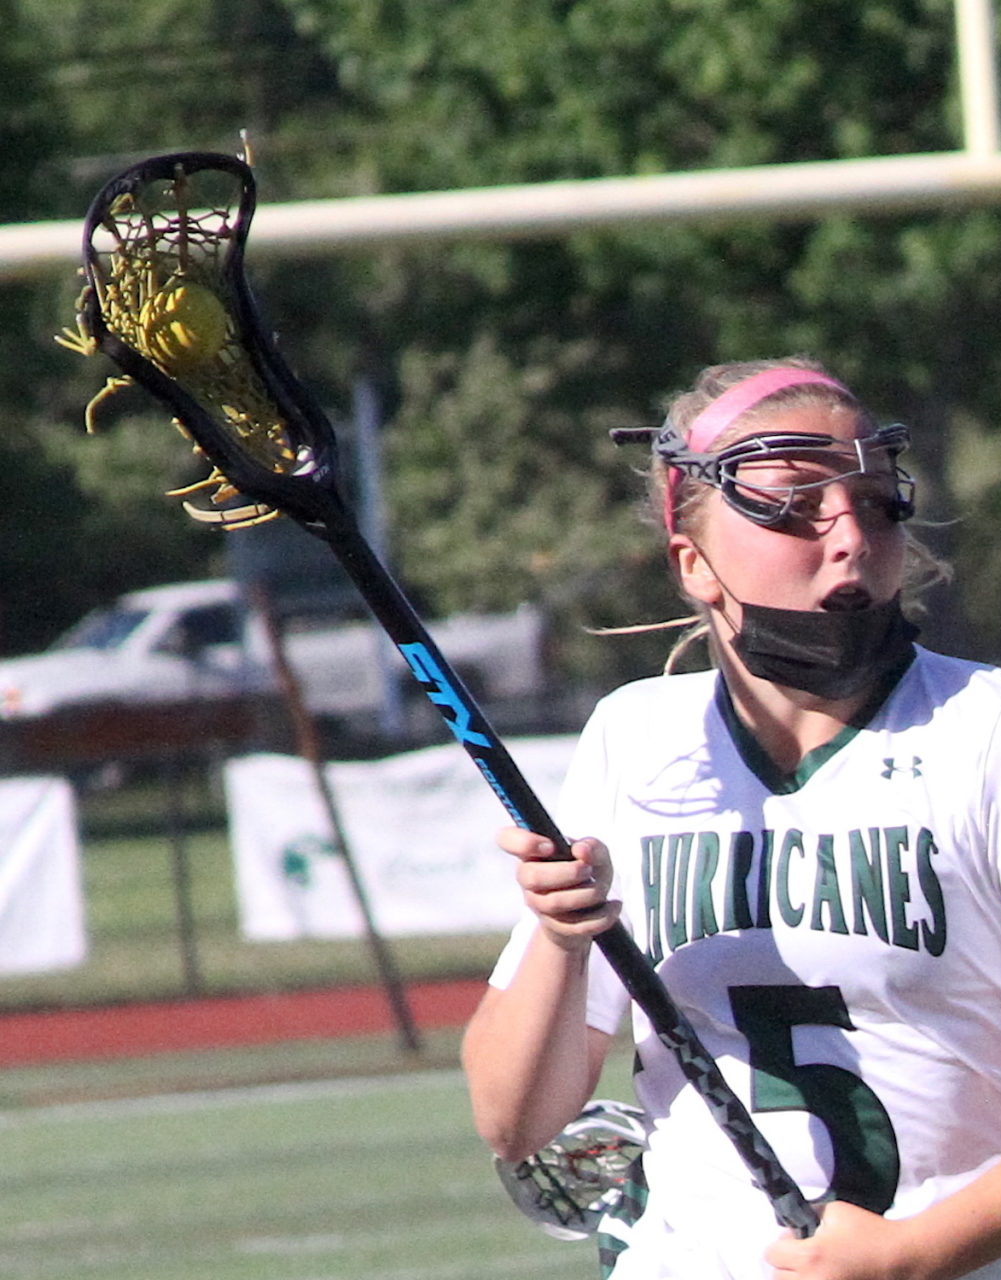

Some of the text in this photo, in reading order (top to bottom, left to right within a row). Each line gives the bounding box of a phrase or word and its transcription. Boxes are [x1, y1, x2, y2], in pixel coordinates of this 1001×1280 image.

[398, 641, 493, 748] STX
[640, 825, 947, 968] HURRICANES
[727, 984, 900, 1216] 5
